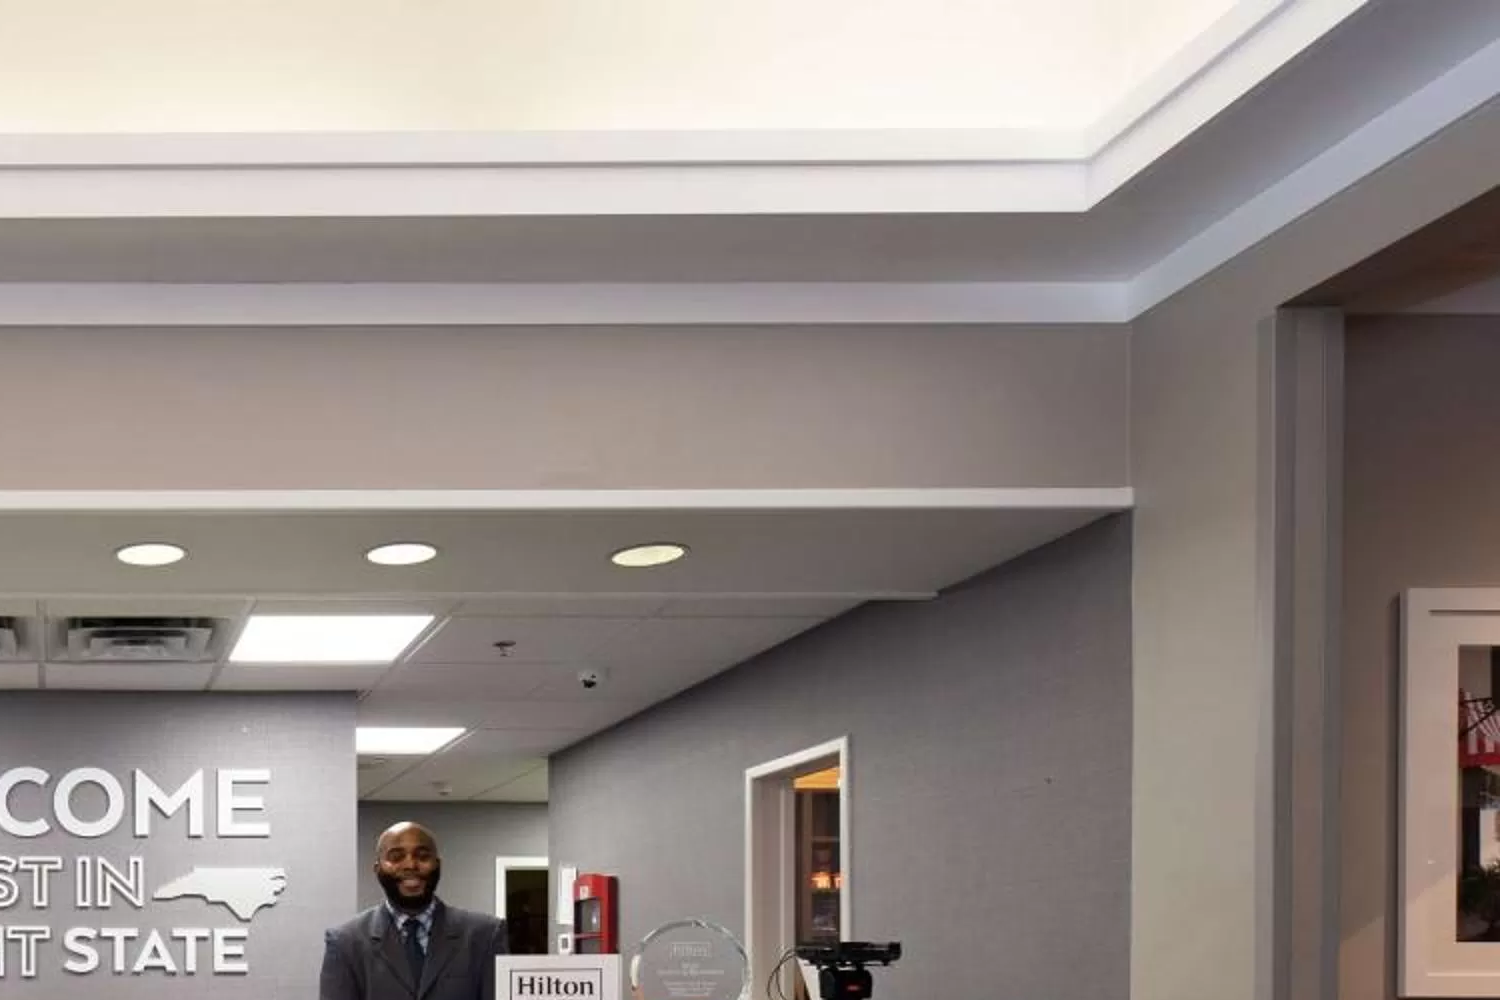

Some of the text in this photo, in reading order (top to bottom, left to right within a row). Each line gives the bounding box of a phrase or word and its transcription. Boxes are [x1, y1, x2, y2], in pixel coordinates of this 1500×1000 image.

[75, 856, 144, 908] IN
[63, 927, 249, 975] STATE
[518, 976, 594, 996] Hilton
